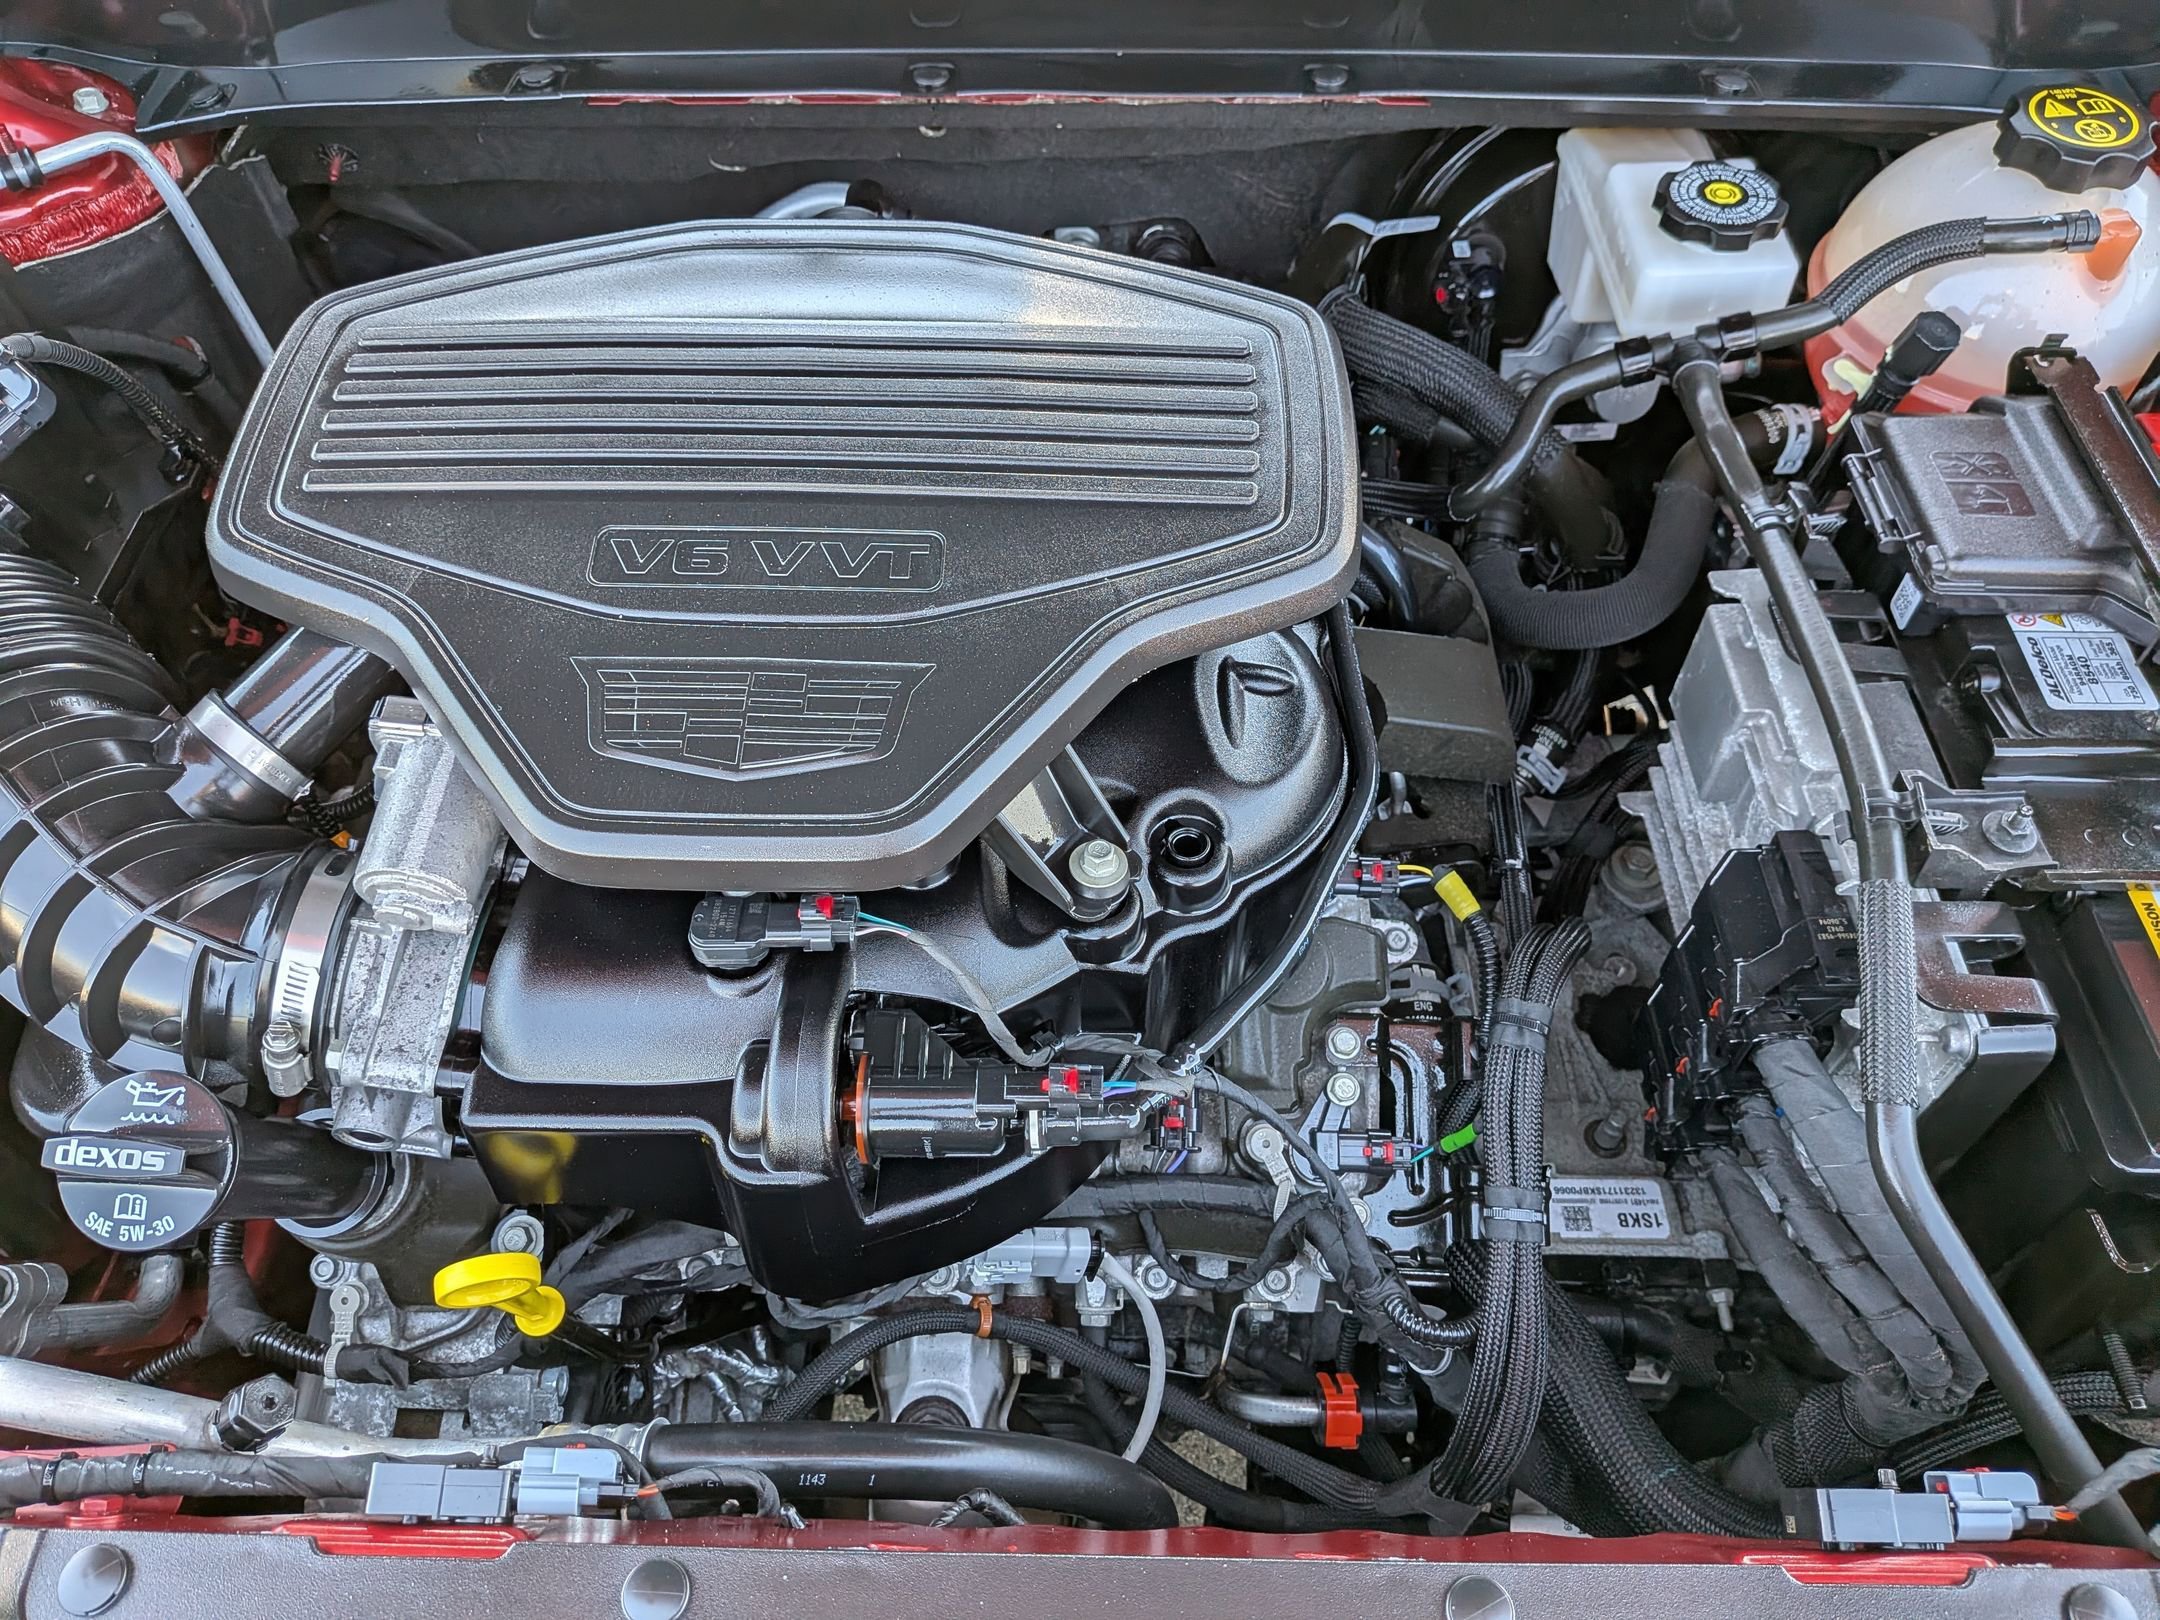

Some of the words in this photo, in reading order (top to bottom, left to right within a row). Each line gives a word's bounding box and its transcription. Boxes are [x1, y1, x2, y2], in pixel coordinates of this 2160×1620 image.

[609, 538, 730, 576] V6
[750, 539, 931, 580] VVT
[2027, 636, 2065, 701] ACDelco
[2076, 656, 2099, 684] 8540
[1413, 1001, 1434, 1012] ENG
[54, 1138, 167, 1172] dexos
[84, 1211, 114, 1238] SAE
[118, 1215, 175, 1242] 5W-30
[1617, 1212, 1663, 1228] 1SKB
[798, 1473, 827, 1486] 1143
[868, 1474, 875, 1486] 1
